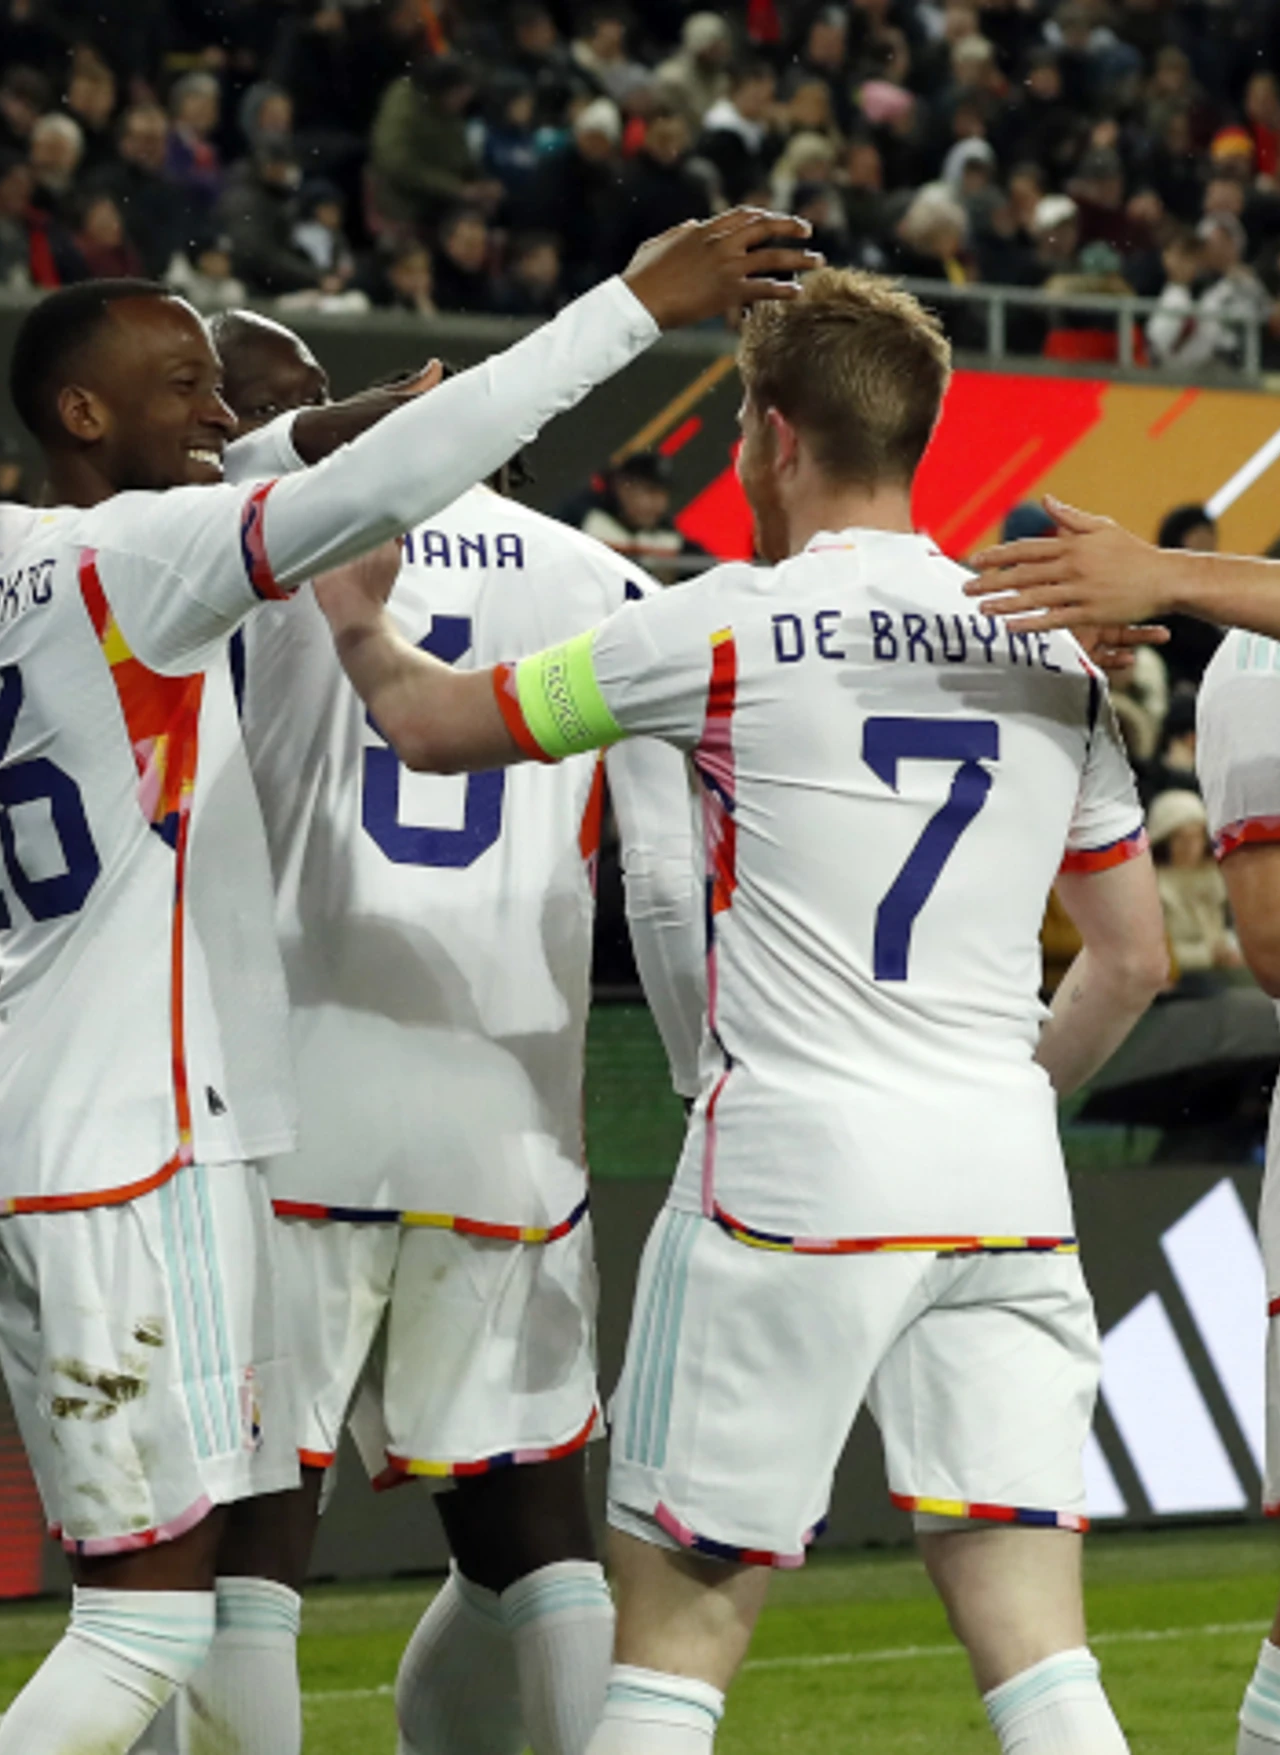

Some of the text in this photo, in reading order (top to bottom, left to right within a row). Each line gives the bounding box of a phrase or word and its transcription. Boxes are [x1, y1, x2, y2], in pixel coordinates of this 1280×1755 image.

[403, 529, 524, 569] ANA
[771, 610, 1062, 673] DE BRUYNE
[861, 716, 1000, 982] 7
